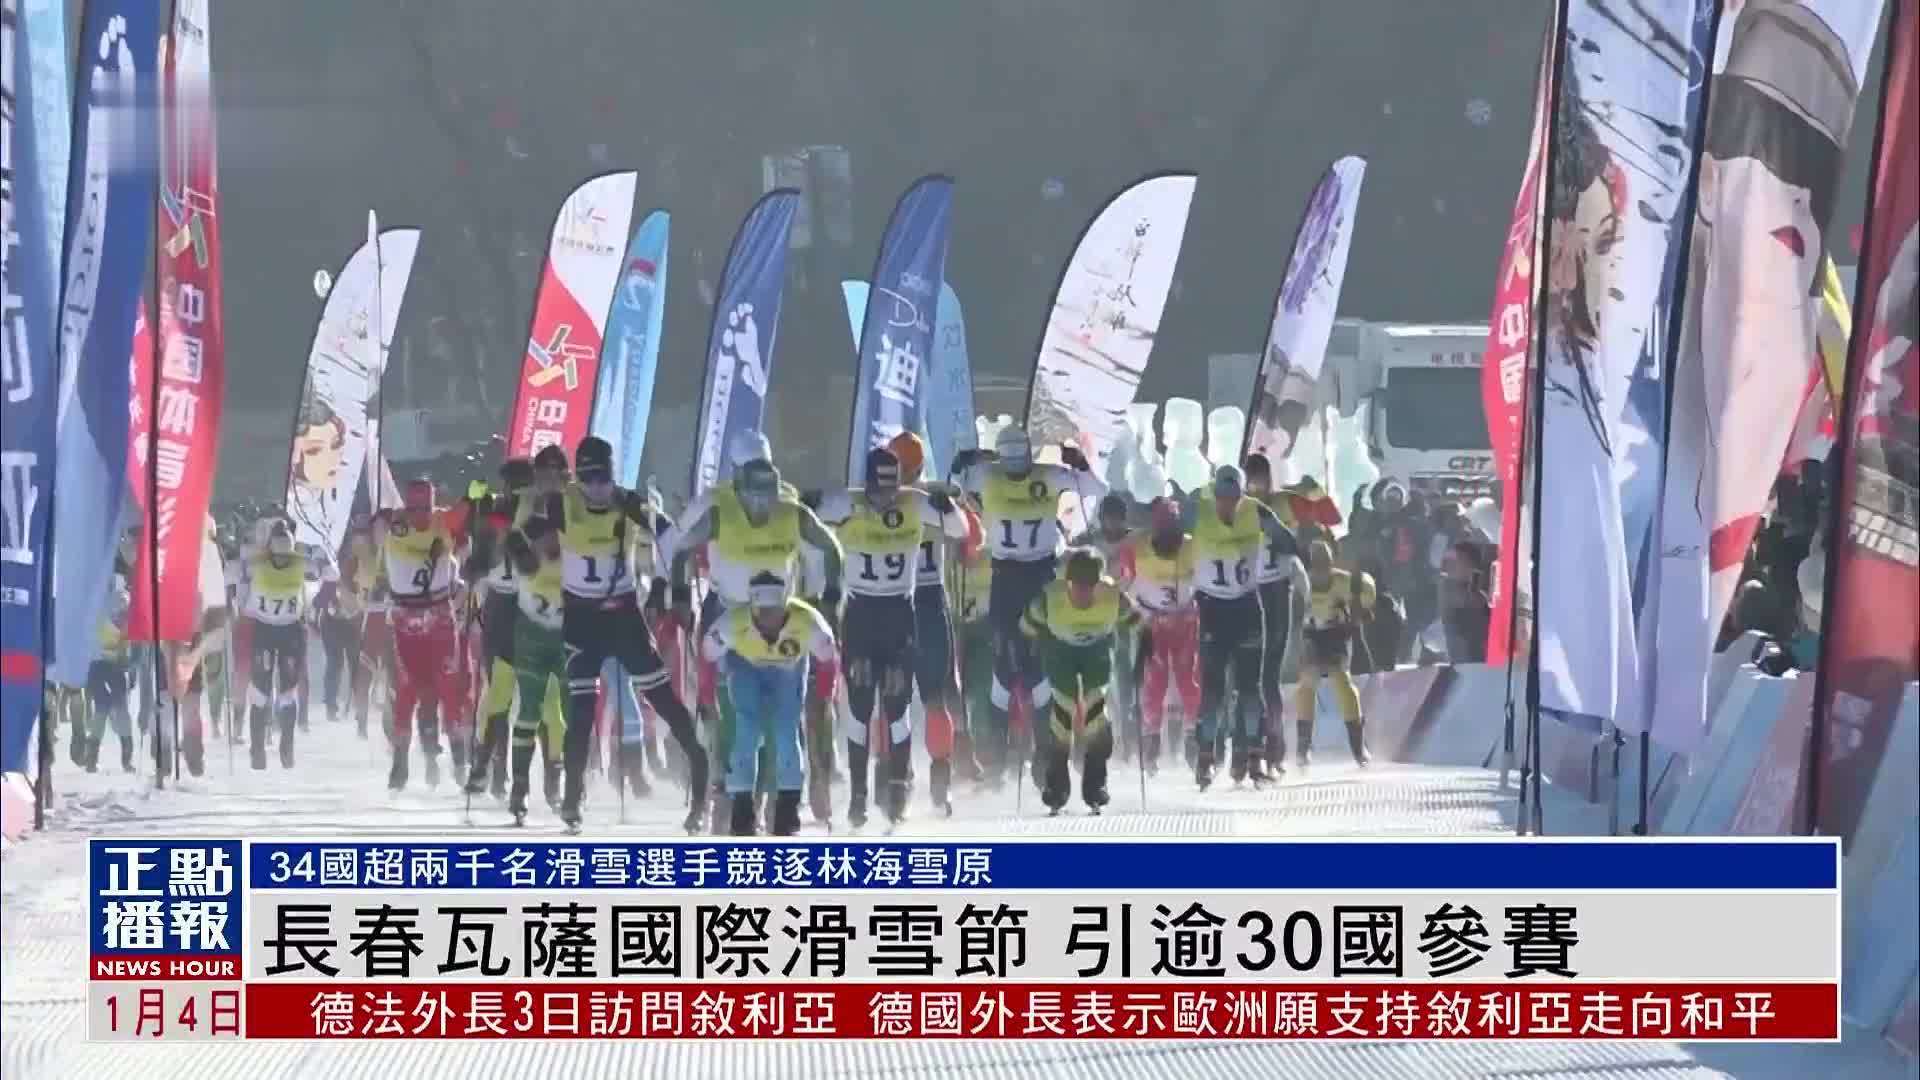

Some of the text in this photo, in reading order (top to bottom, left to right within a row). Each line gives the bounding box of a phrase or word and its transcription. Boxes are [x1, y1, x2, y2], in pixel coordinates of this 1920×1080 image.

[1000, 519, 1043, 549] 17
[859, 551, 906, 582] 19
[1209, 557, 1251, 587] 16
